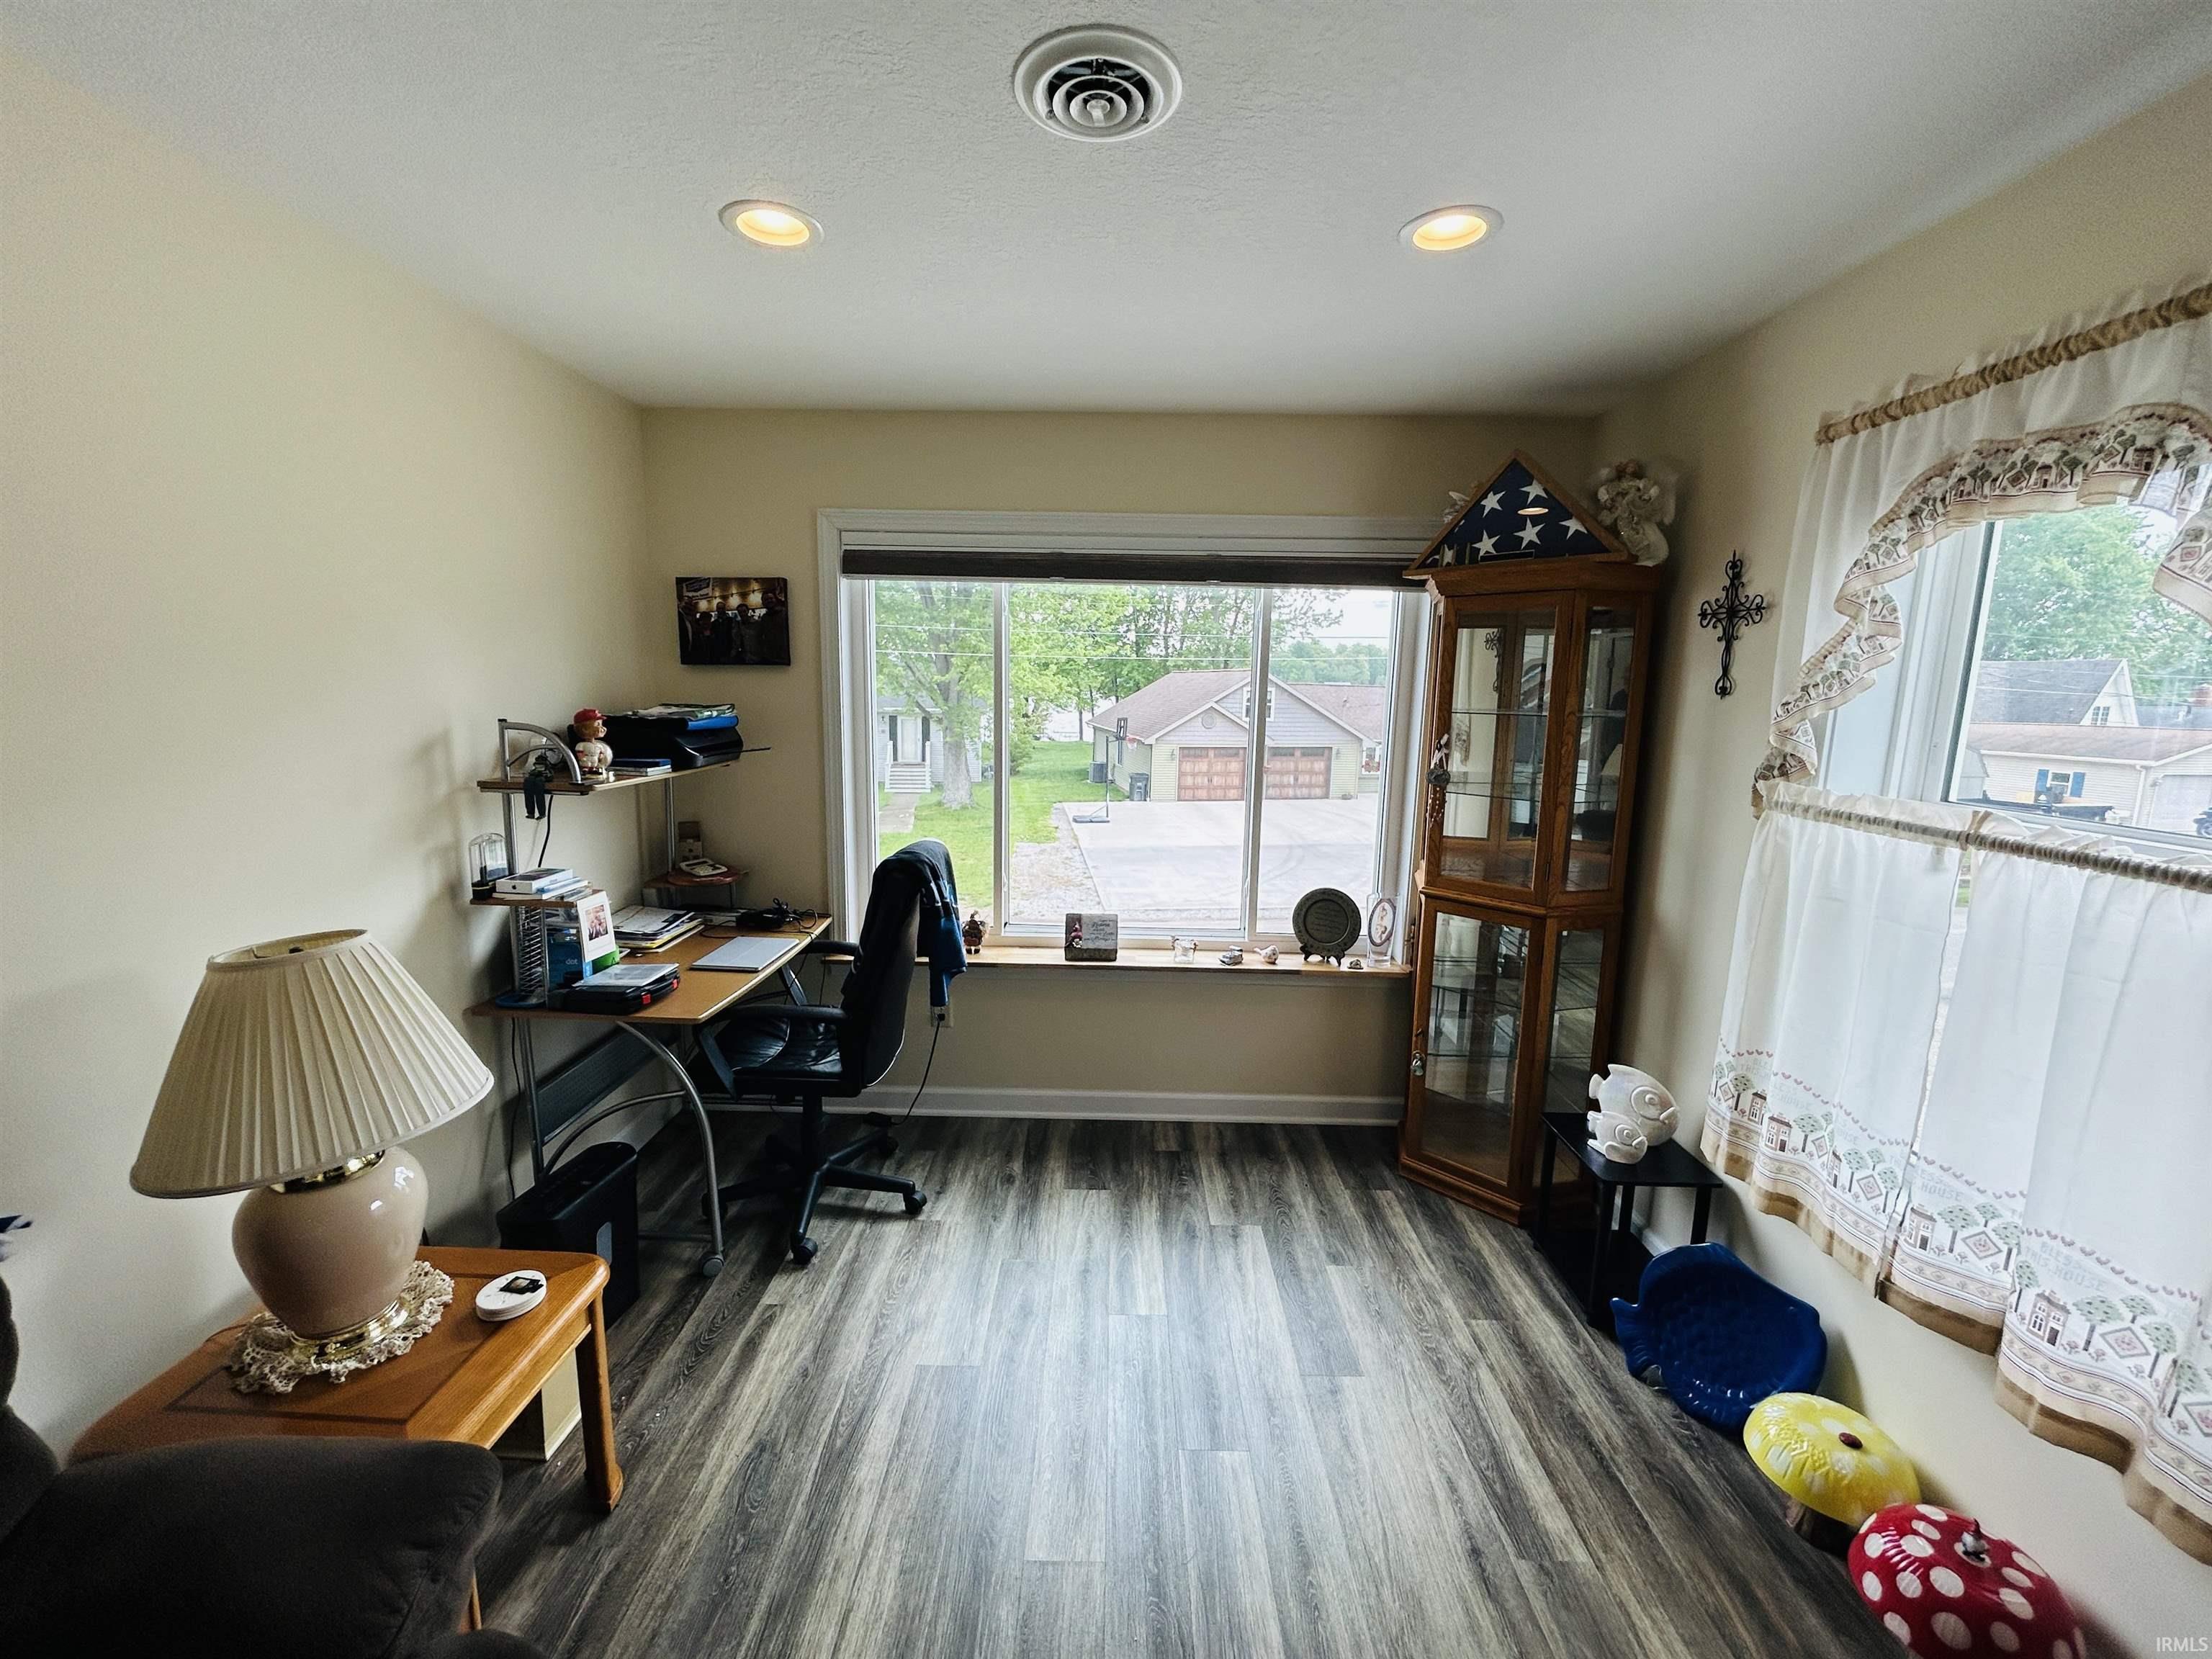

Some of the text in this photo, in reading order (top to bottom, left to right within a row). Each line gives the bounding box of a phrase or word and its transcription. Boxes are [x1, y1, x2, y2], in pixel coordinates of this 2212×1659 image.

[1921, 1182, 1964, 1202] HOUSE
[2041, 1241, 2086, 1272] BLESS
[2054, 1265, 2108, 1292] HOUSE
